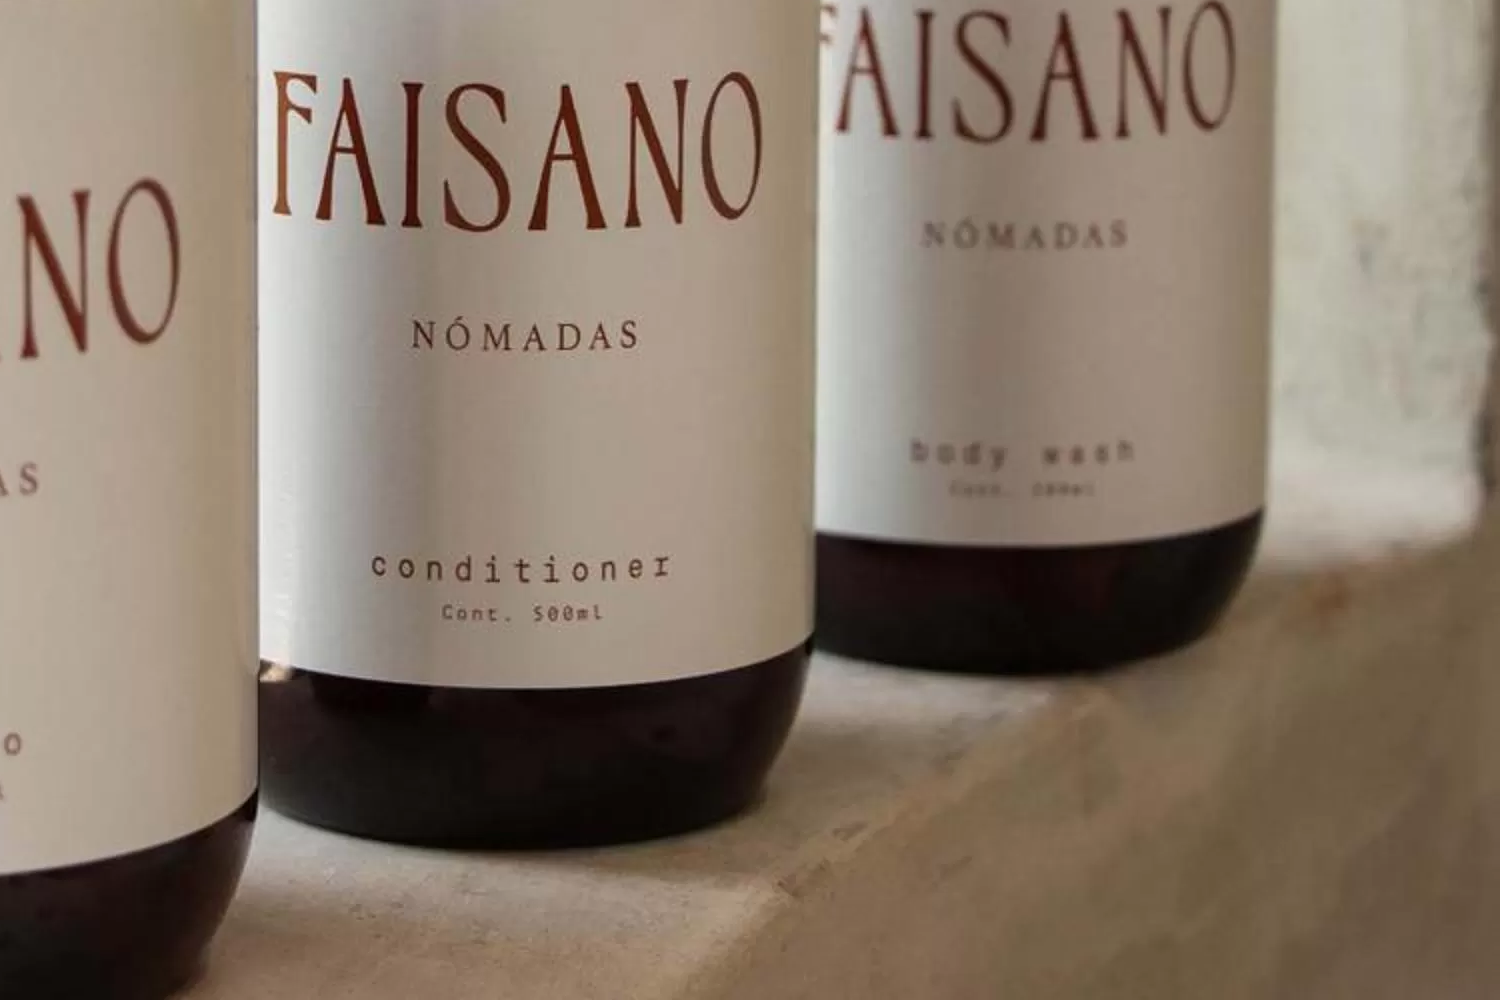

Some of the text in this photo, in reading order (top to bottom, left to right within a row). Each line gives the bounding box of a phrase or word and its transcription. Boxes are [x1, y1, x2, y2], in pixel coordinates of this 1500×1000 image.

[272, 71, 762, 232] FAISANO
[921, 219, 1128, 249] NÓMADAS
[412, 316, 639, 352] NÓMADAS
[371, 555, 669, 583] conditioner
[441, 604, 604, 622] Cont. 500ml
